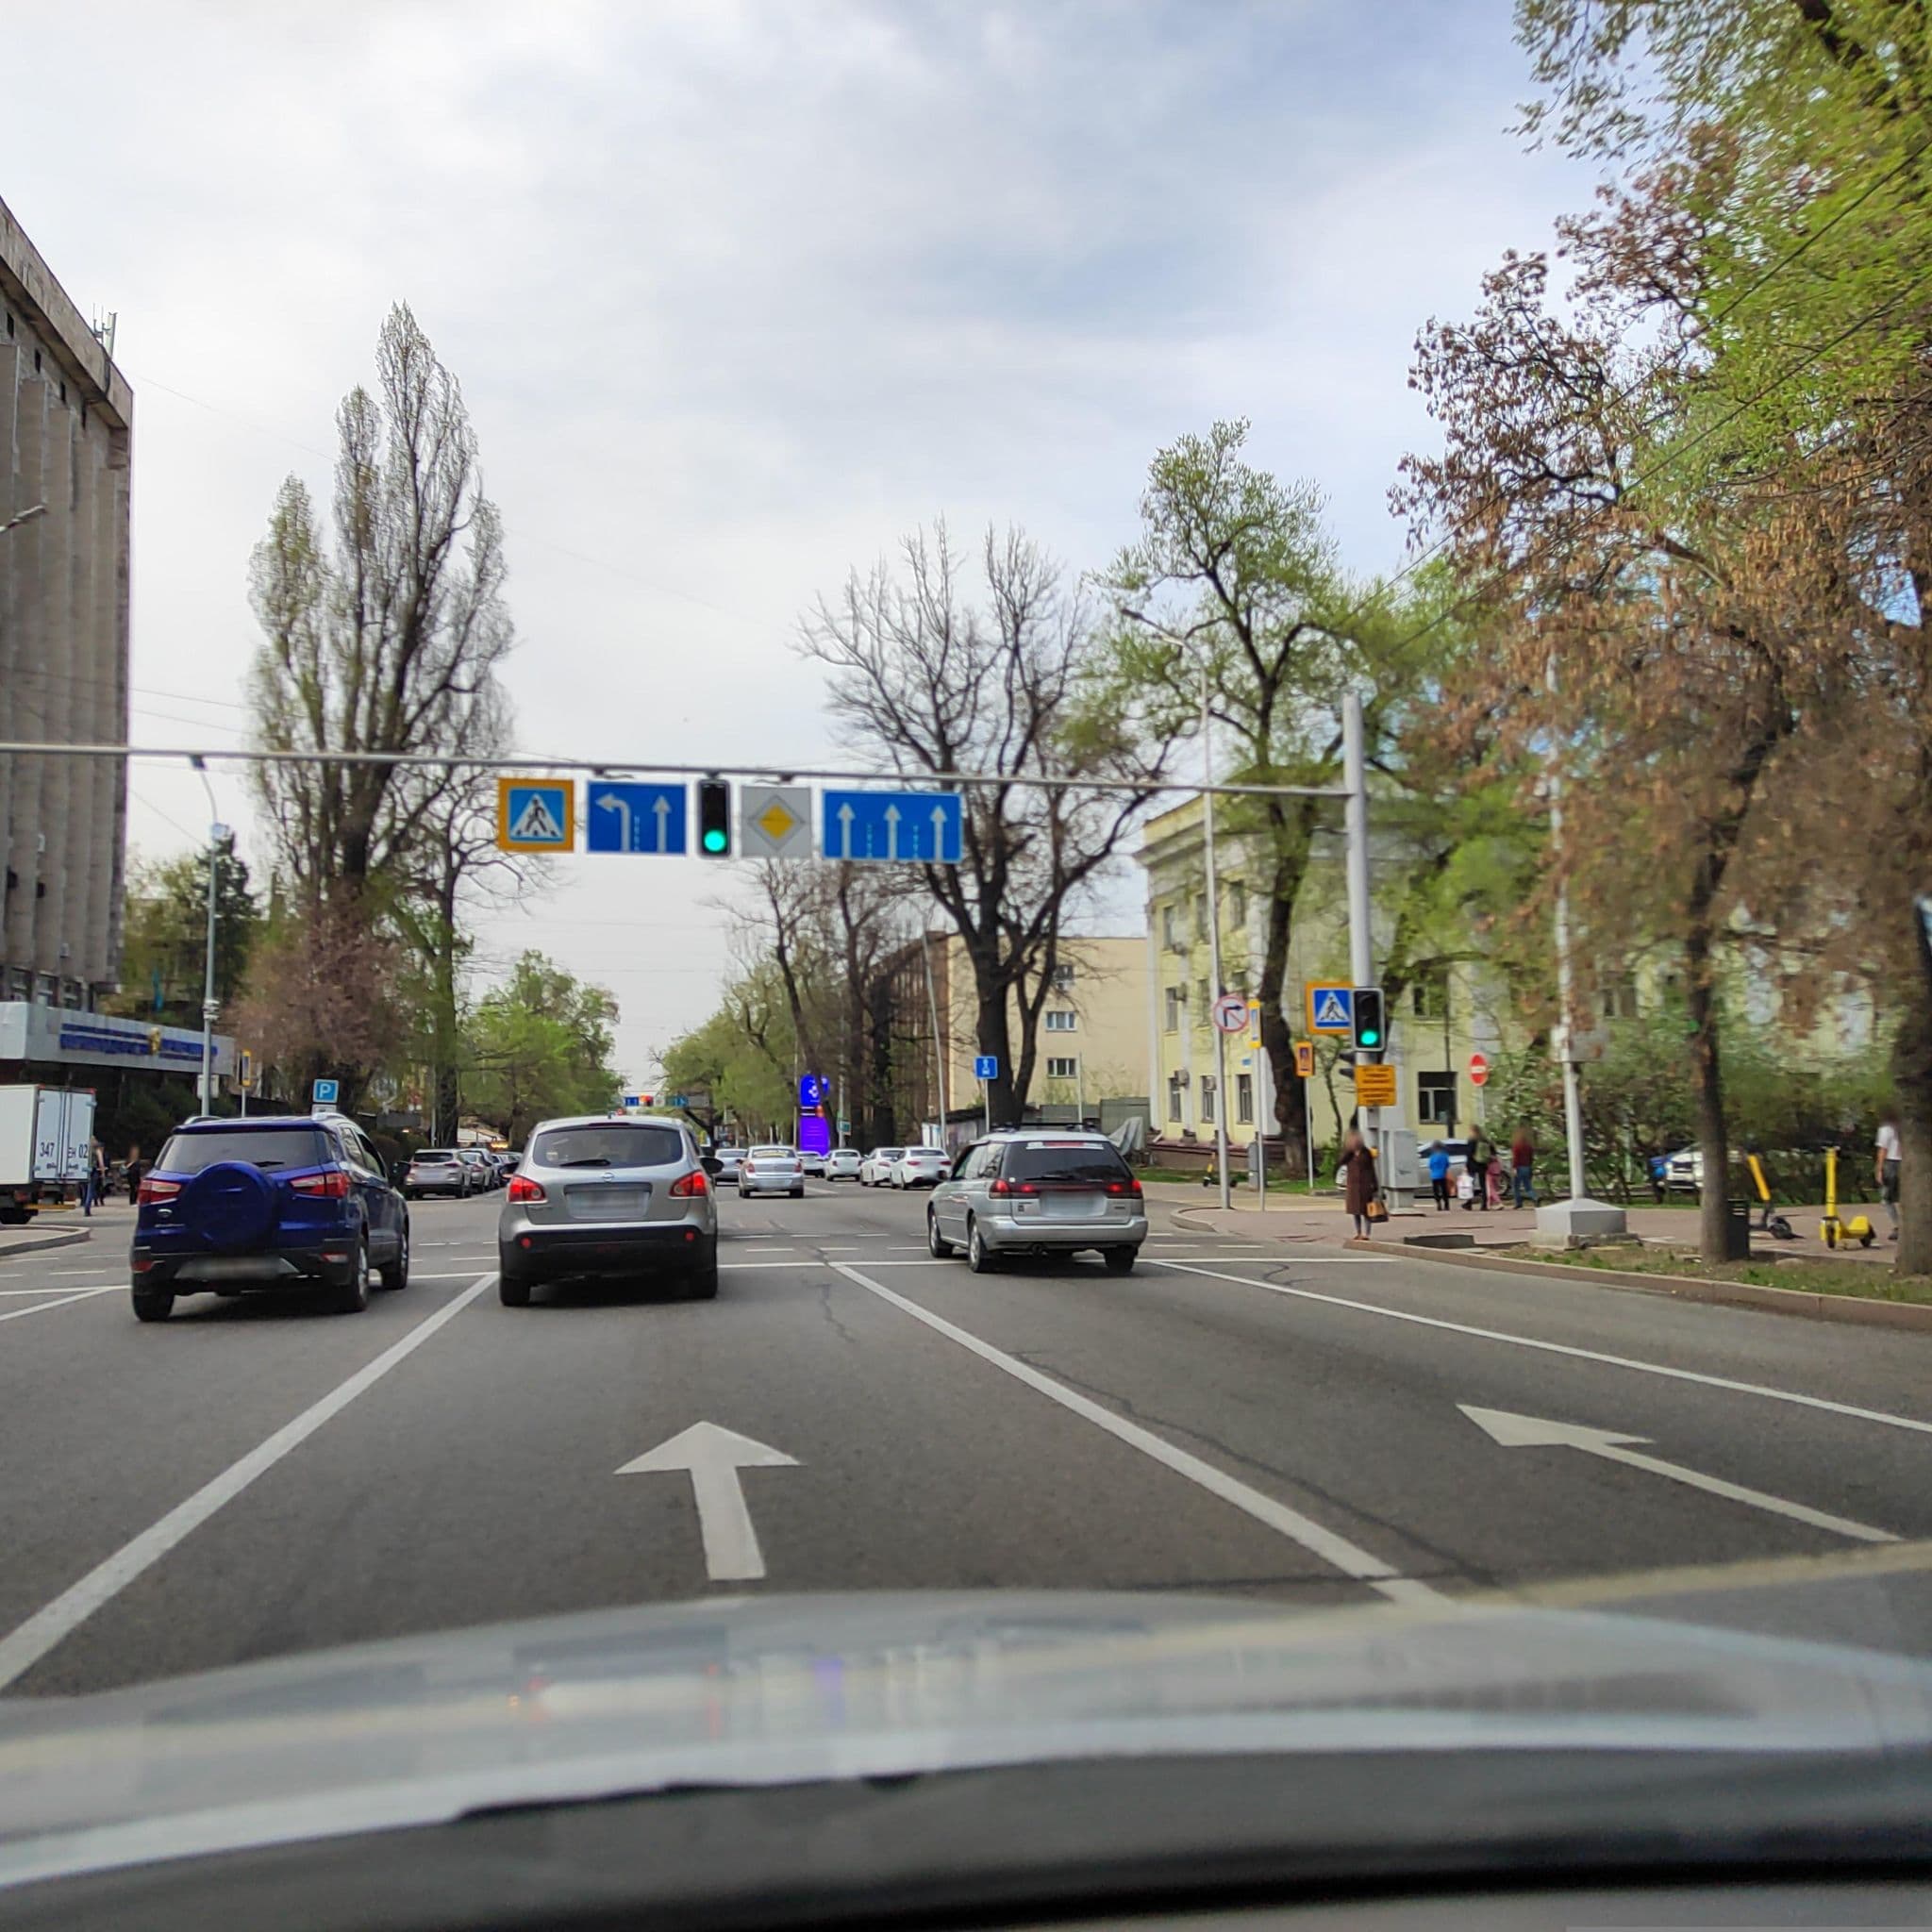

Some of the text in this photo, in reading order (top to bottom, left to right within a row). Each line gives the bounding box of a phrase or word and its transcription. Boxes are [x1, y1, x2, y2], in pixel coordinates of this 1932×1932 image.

[319, 1083, 331, 1099] P
[40, 1141, 55, 1158] 347
[78, 1143, 88, 1158] 02
